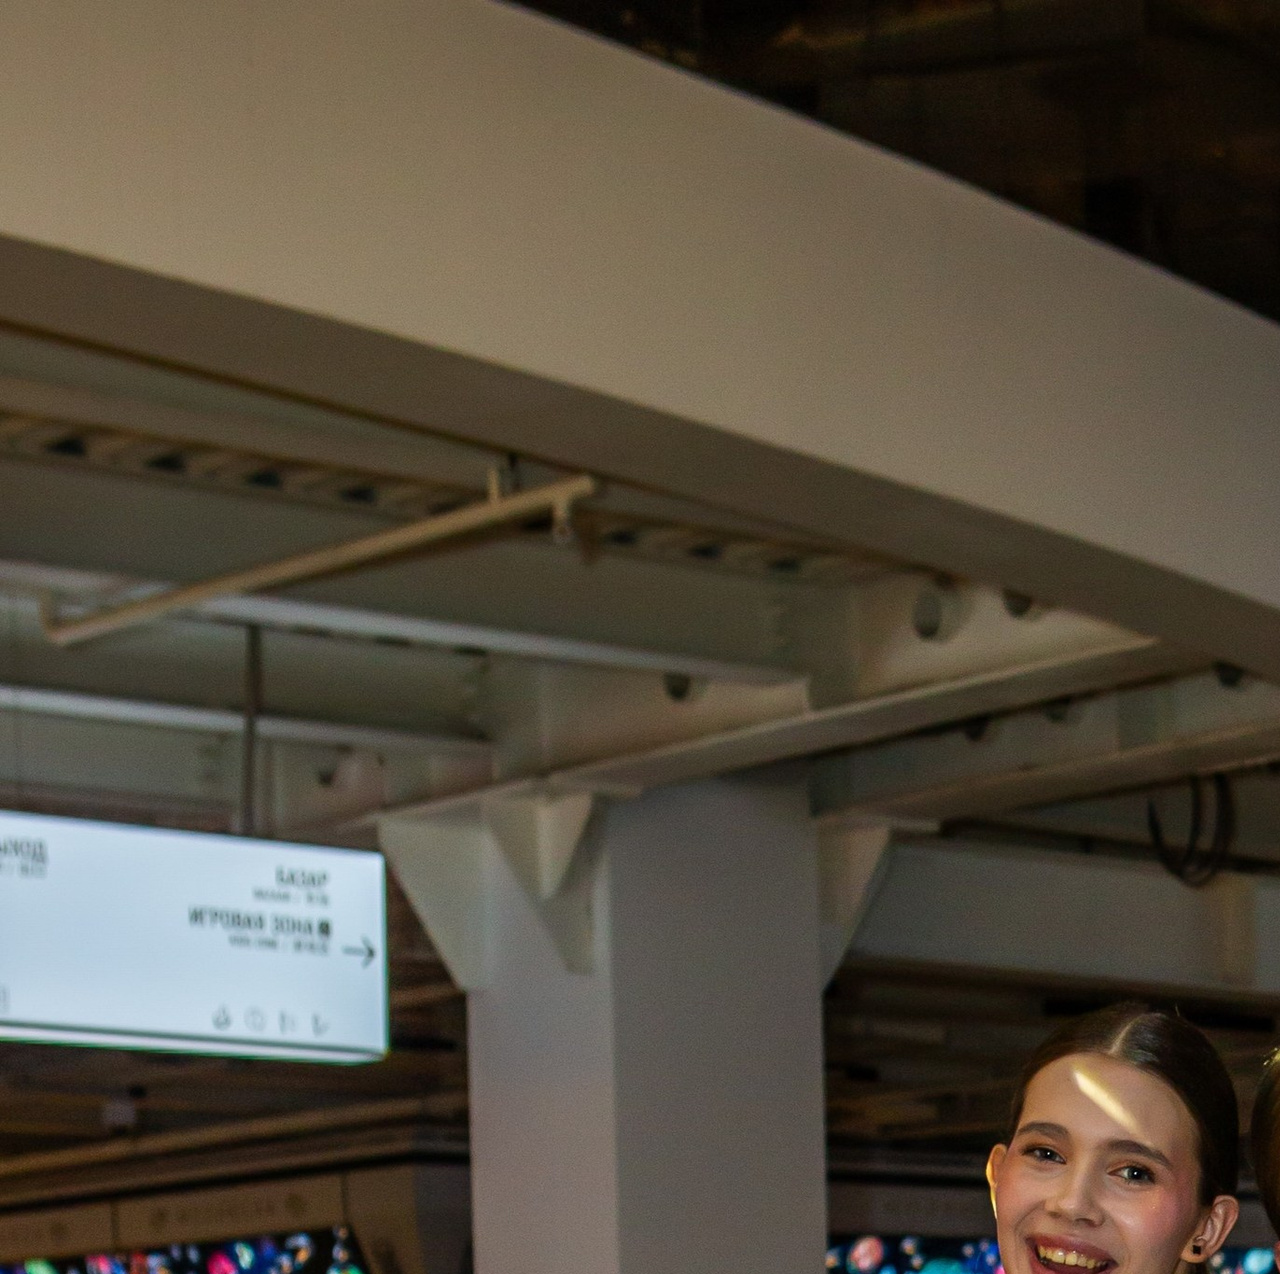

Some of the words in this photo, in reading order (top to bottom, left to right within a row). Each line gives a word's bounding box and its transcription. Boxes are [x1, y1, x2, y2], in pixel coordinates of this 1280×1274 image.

[275, 865, 330, 888] БАЗАР
[188, 906, 265, 930] ИГРОВАЯ
[271, 913, 315, 937] ЗОНА
